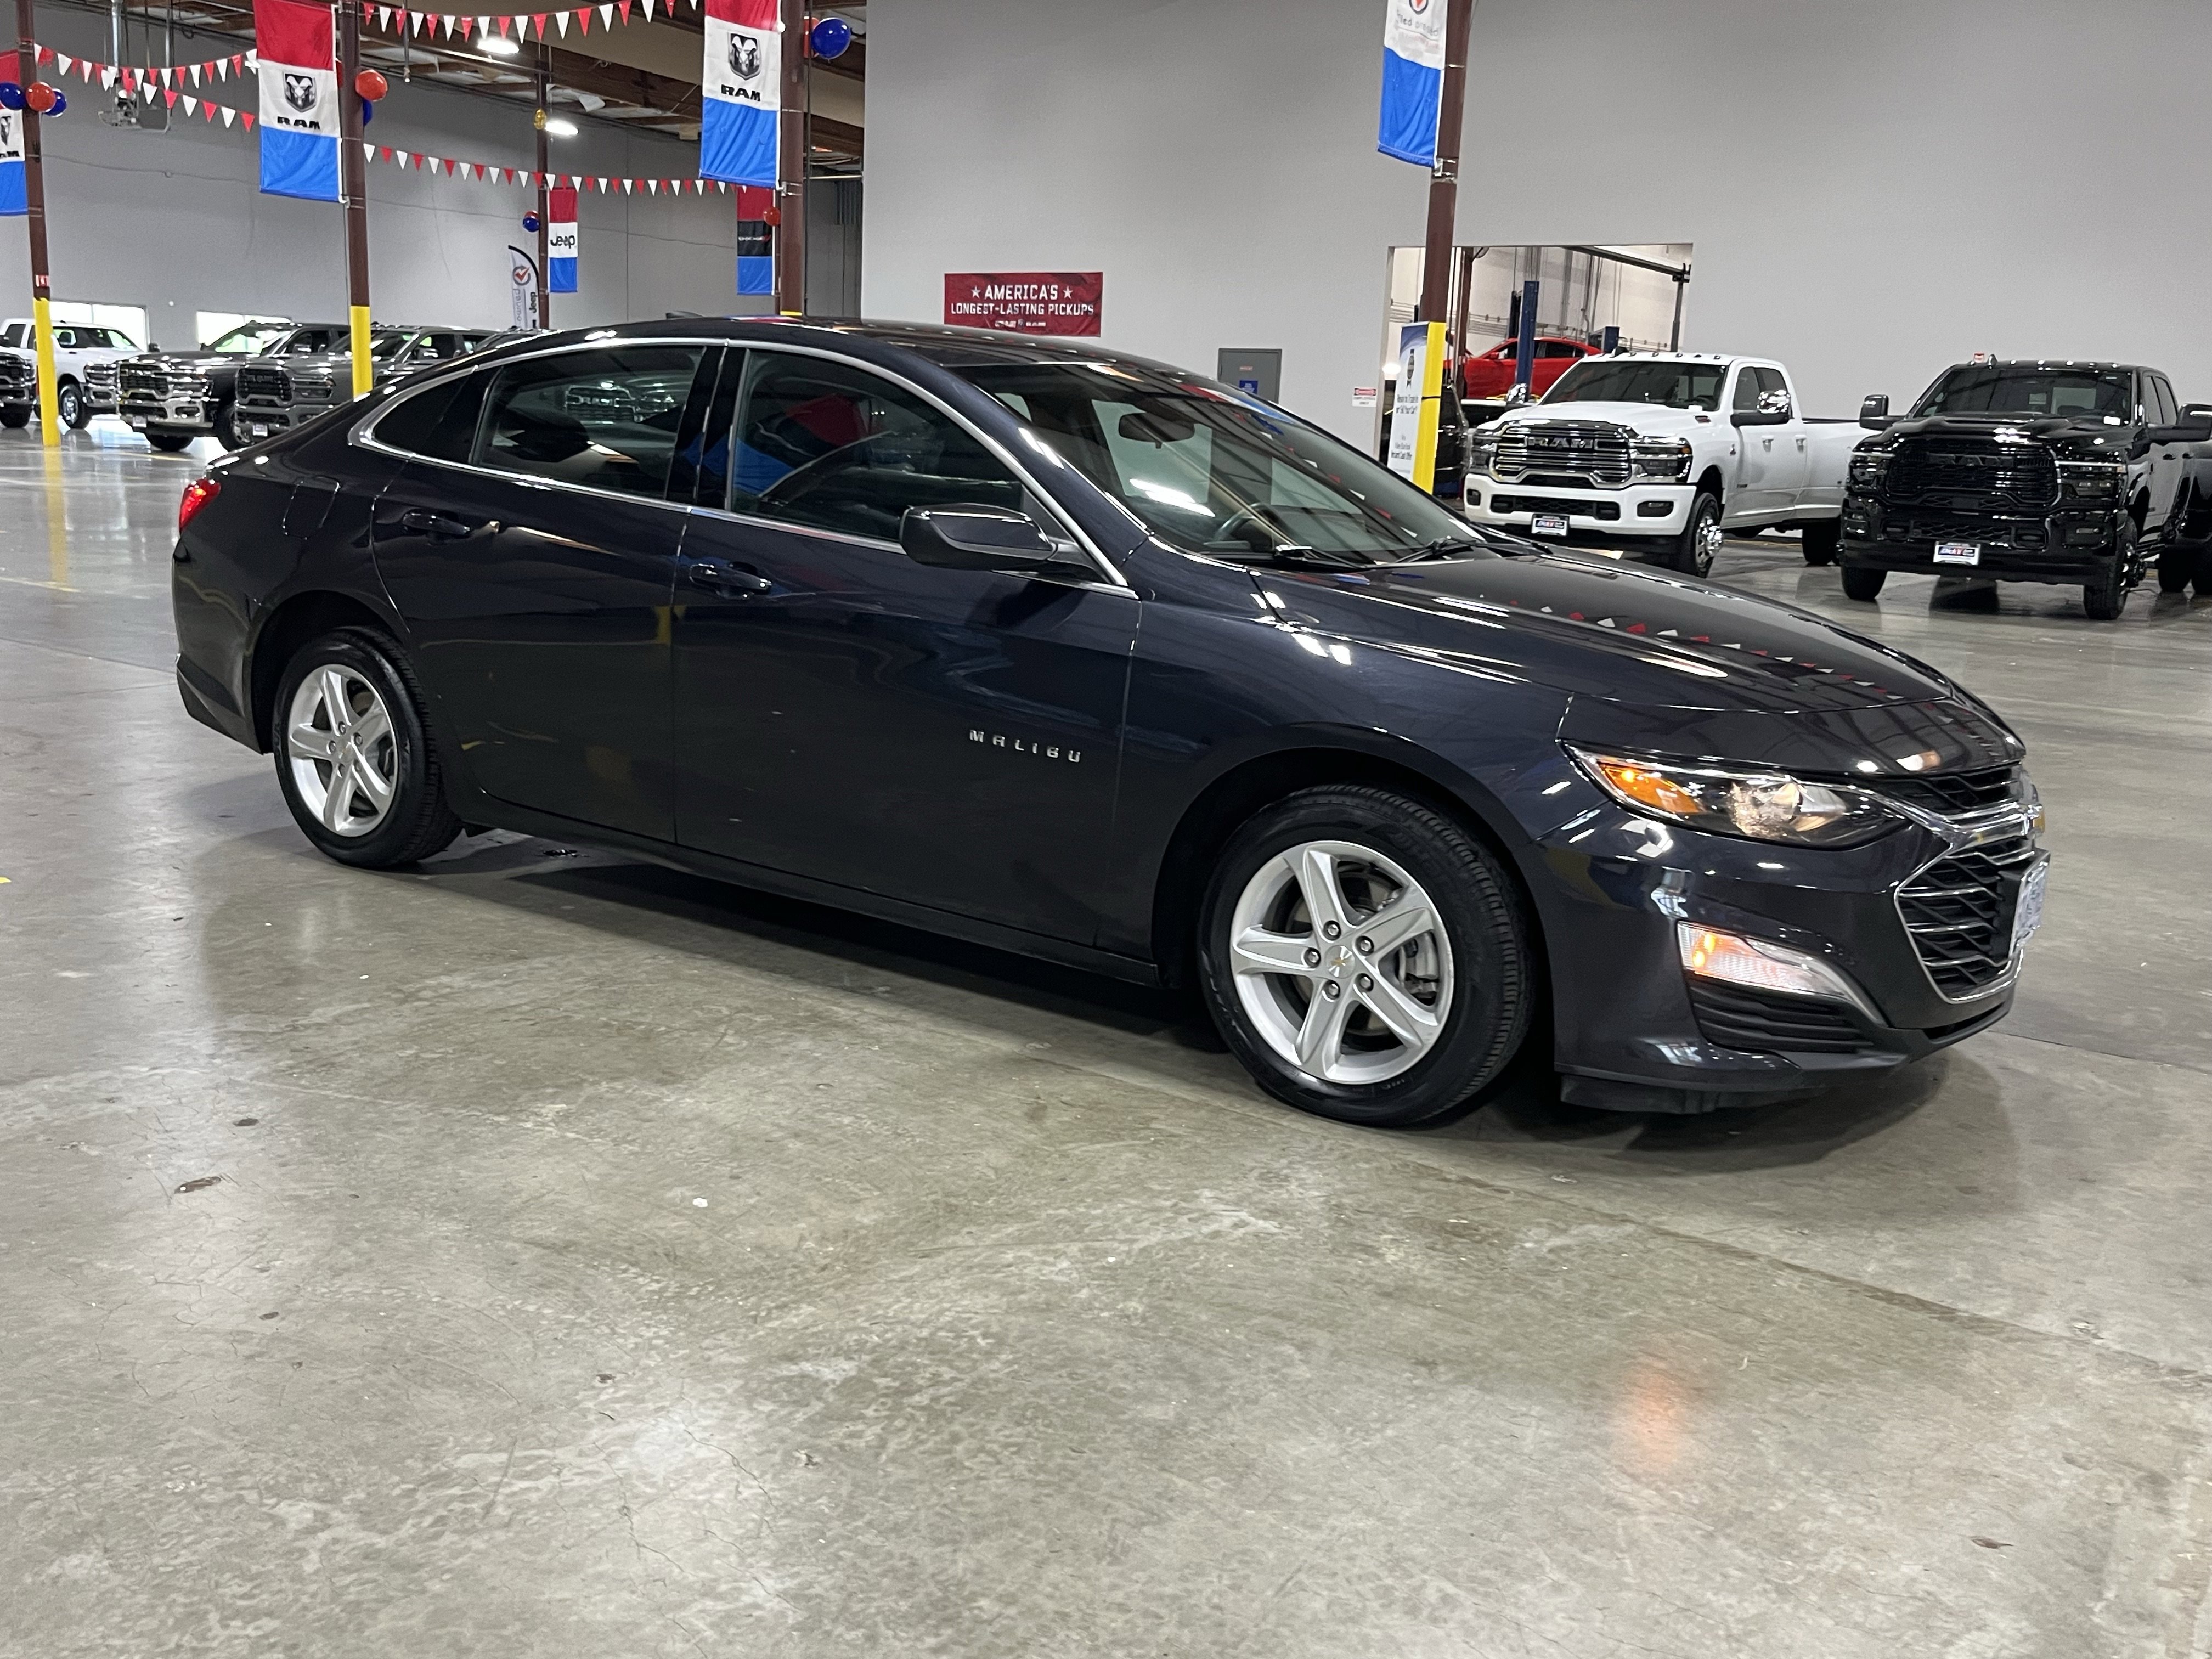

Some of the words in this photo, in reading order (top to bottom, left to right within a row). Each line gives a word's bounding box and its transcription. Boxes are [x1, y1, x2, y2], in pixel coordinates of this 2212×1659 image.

[721, 84, 761, 102] RAM
[277, 116, 320, 130] RAM
[550, 235, 575, 249] Jeep
[984, 285, 1058, 300] AMERICA'S
[951, 303, 1045, 315] LONGEST-LASTING
[1048, 303, 1094, 315] PICKUPS
[1528, 437, 1593, 448] RAM
[969, 729, 1081, 763] MALIBU
